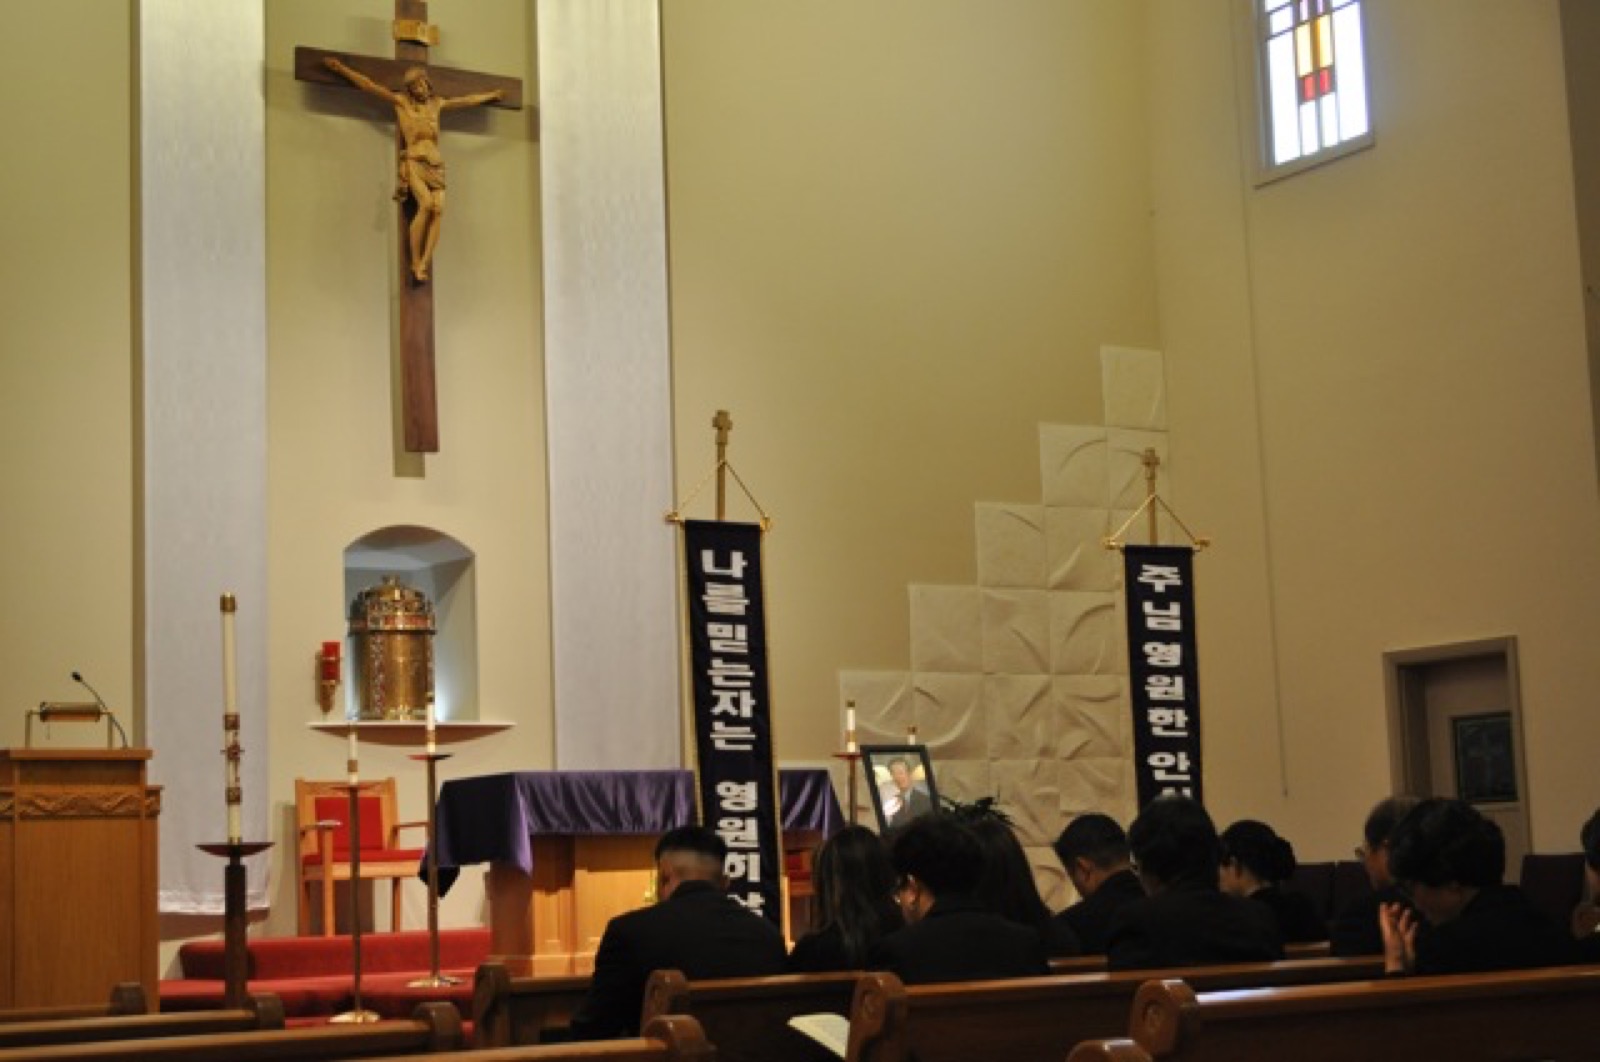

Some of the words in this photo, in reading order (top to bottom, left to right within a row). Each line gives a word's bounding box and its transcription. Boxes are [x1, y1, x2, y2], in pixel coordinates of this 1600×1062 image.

[1137, 564, 1183, 631] 주님
[1142, 641, 1189, 738] 영원한
[1147, 751, 1192, 797] 안
